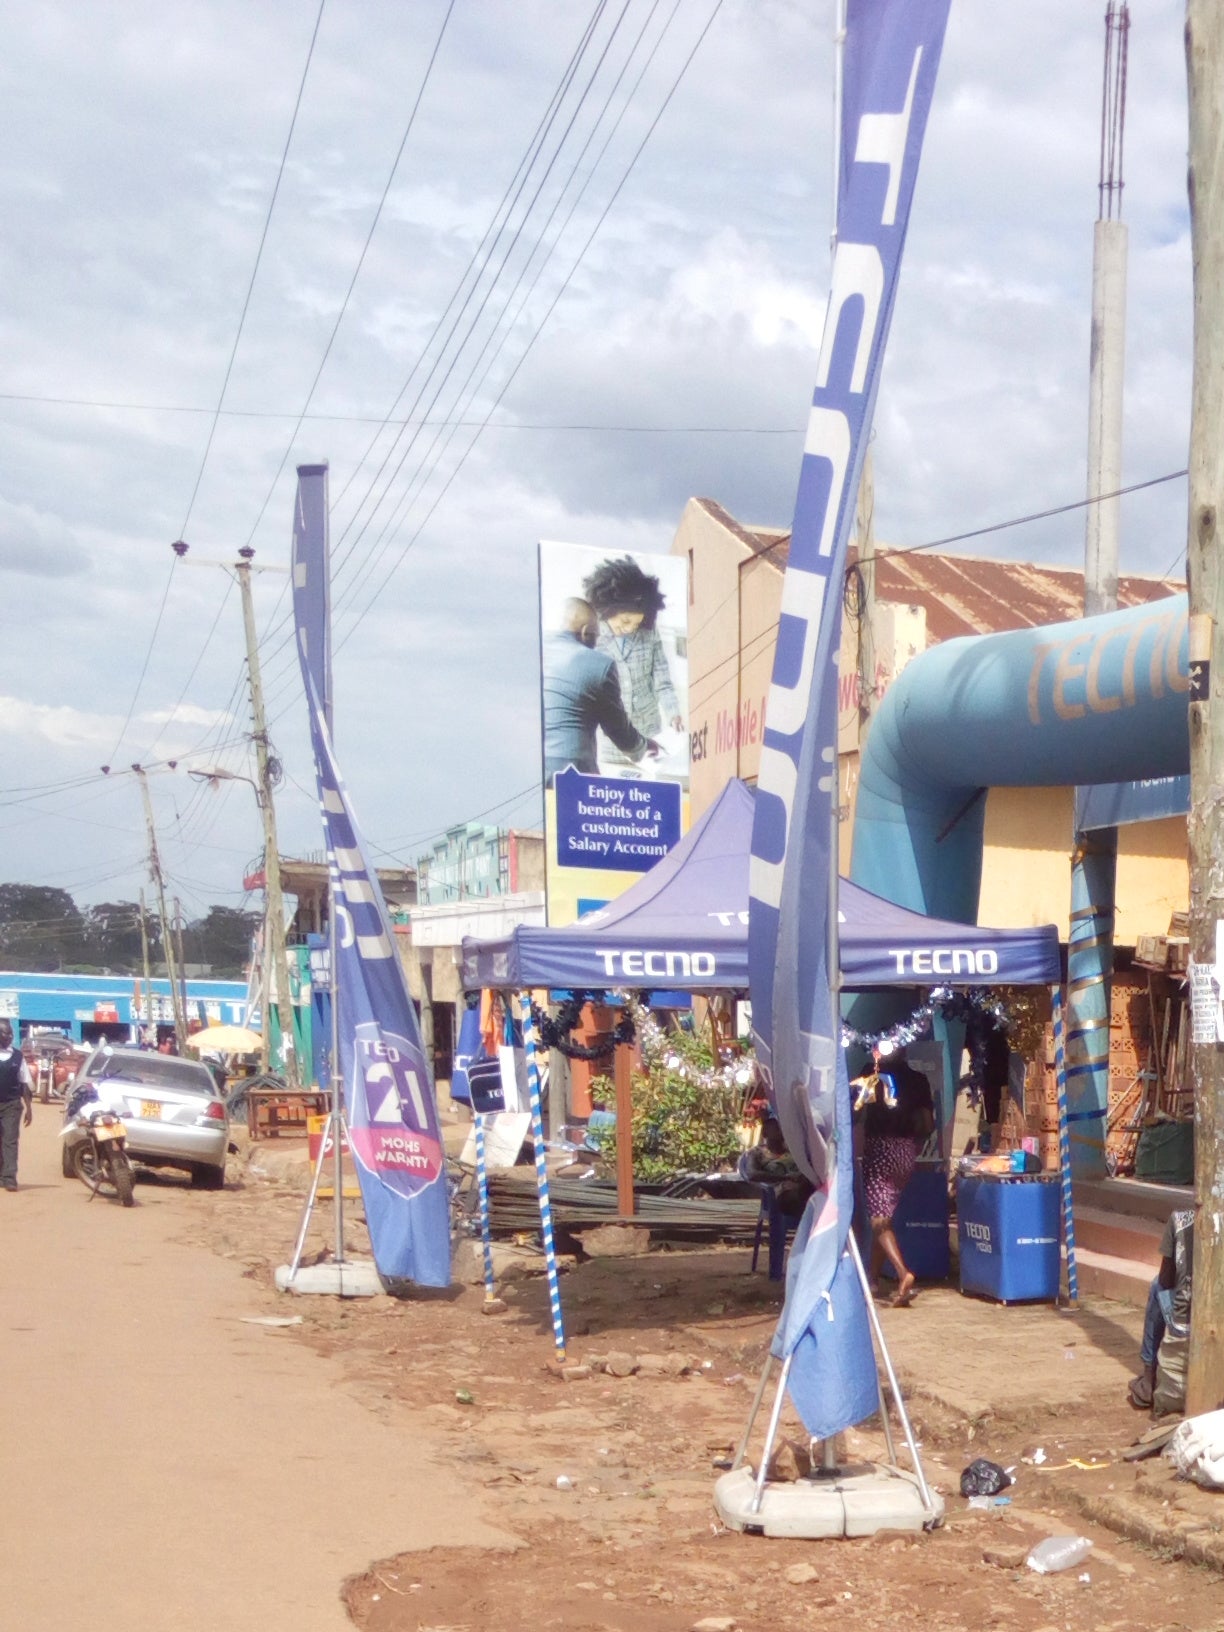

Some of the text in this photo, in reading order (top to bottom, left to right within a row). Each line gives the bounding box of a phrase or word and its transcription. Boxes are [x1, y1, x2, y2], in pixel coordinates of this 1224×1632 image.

[588, 785, 651, 804] Enjoy the
[577, 801, 662, 821] benefits of a
[581, 822, 659, 838] customised
[568, 836, 668, 856] Salary Account
[595, 950, 716, 977] TECNO
[888, 950, 998, 975] TECNO
[965, 1222, 990, 1241] TECNO
